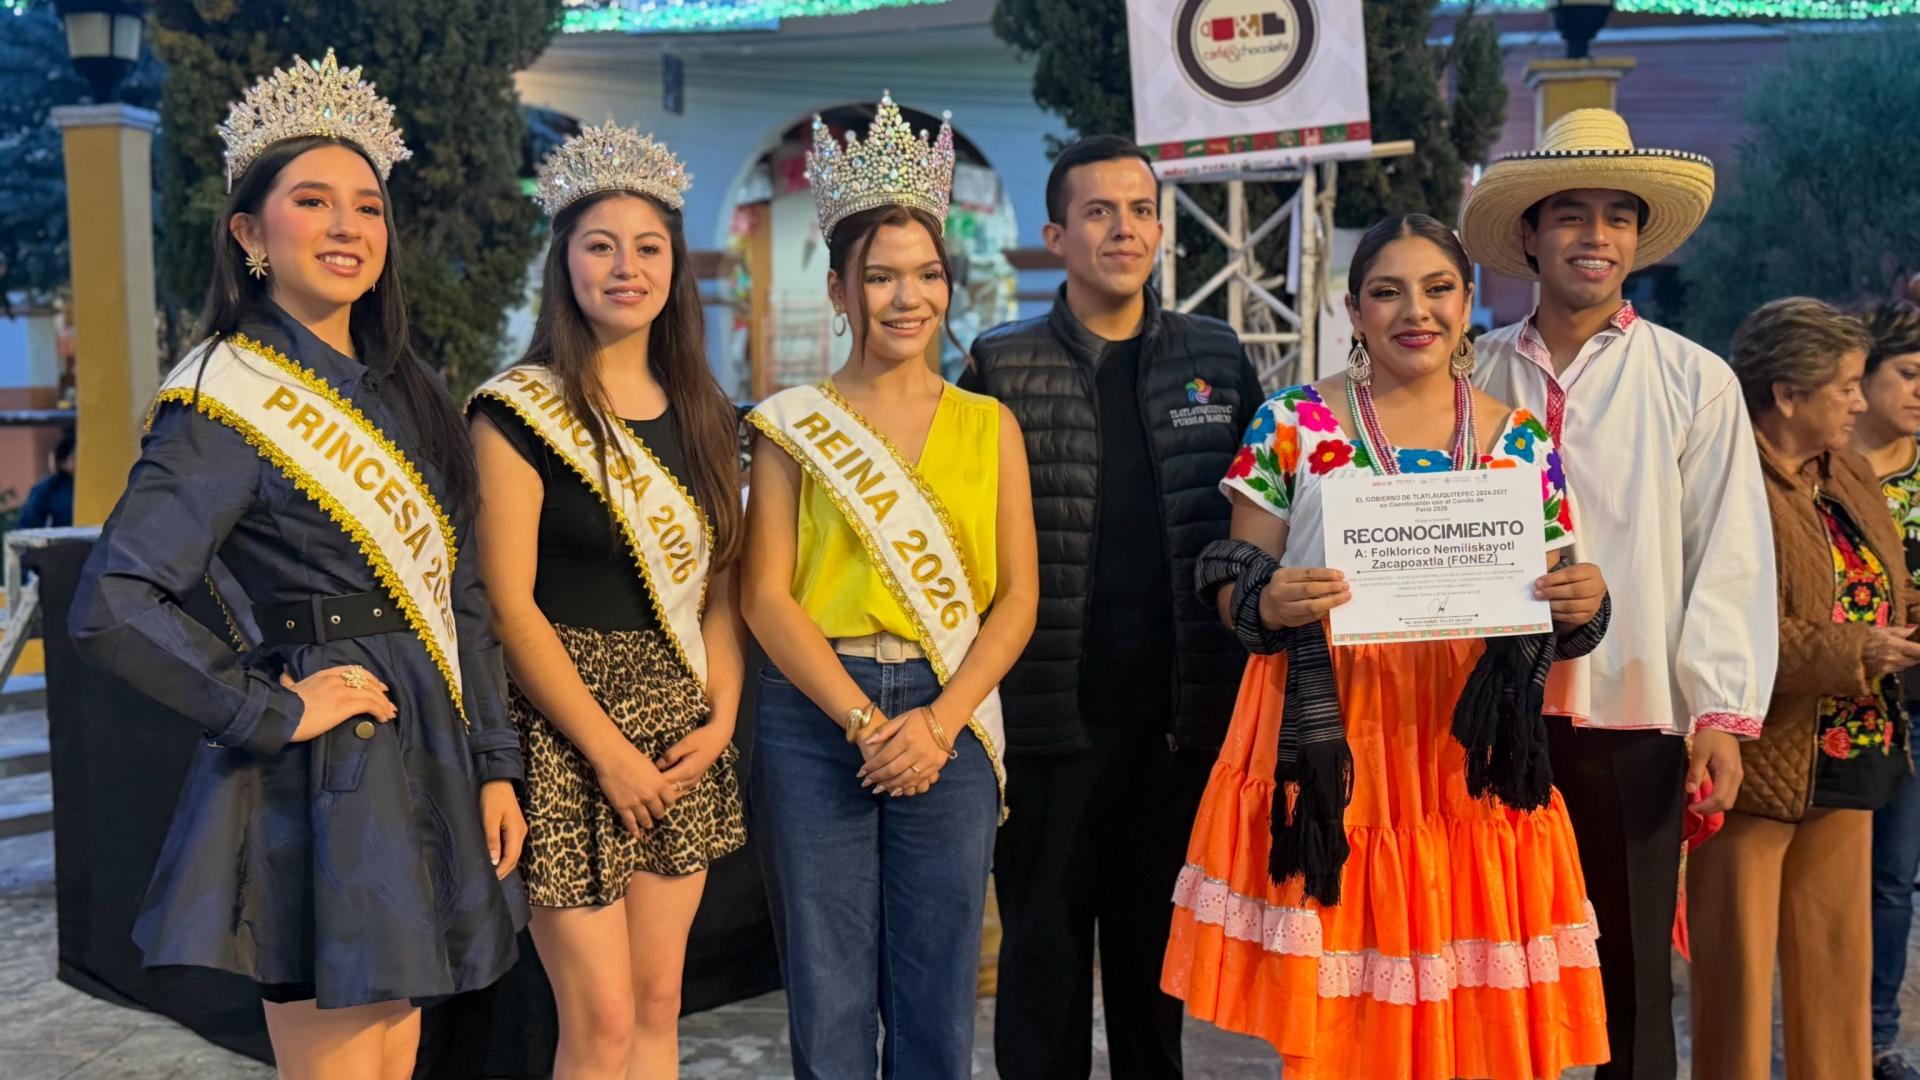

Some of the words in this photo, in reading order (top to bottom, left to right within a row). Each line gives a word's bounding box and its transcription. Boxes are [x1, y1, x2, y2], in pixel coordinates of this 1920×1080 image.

[262, 384, 433, 562] PRINCESA
[496, 369, 653, 504] PRINCSA
[647, 504, 699, 585] 2026
[1365, 495, 1400, 503] GOBIERNO
[1413, 490, 1475, 500] TLATLAUQUITEPEC
[792, 411, 900, 525] REINA
[891, 529, 968, 631] 2026
[1343, 520, 1524, 545] RECONOCIMIENTO
[1355, 548, 1367, 559] A:
[1371, 547, 1431, 558] Folklorico
[1434, 541, 1515, 554] Nemiliskayotl
[1371, 557, 1444, 570] Zacapoaxtla
[1447, 553, 1499, 568] (FONEZ)
